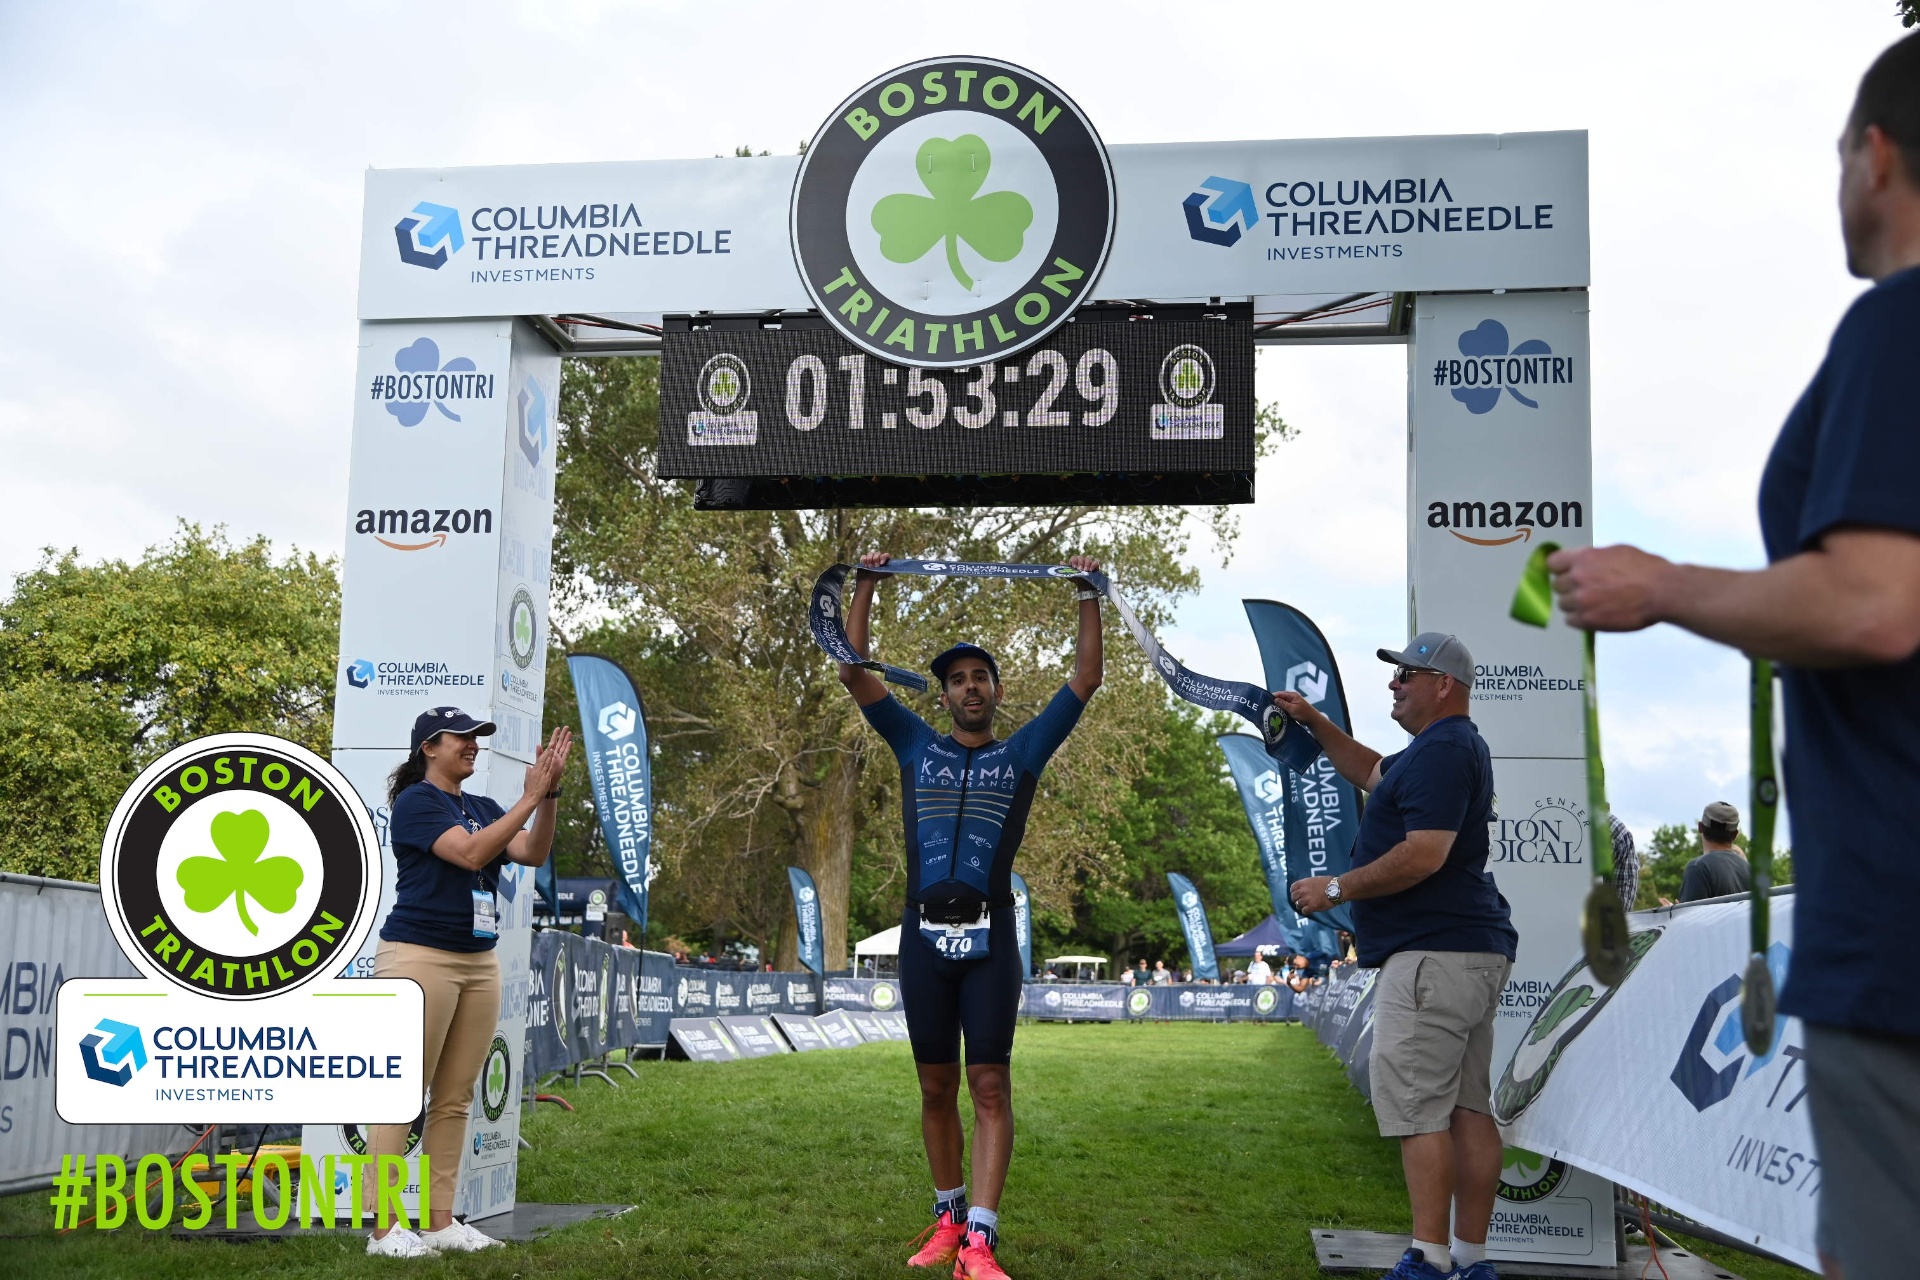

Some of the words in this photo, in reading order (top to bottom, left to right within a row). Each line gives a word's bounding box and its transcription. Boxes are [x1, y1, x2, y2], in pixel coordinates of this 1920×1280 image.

[844, 69, 1063, 142] BOSTON
[1265, 177, 1453, 208] COLUMBIA
[472, 202, 643, 233] COLUMBIA
[1266, 204, 1554, 238] THREADNEEDLE
[472, 229, 732, 261] THREADNEEDLE
[1267, 244, 1403, 261] INVESTMENTS
[470, 267, 595, 283] INVESTMENTS
[823, 255, 1085, 356] TRIATHLON
[1433, 356, 1574, 387] #BOSTONTRI
[371, 373, 495, 400] #BOSTONTRI
[785, 348, 1119, 432] 01:53:29
[356, 508, 492, 534] amazon
[1427, 501, 1583, 529] amazon
[378, 662, 448, 674] COLUMBIA
[378, 674, 485, 686] THREADNEEDLE
[1475, 665, 1544, 677] OLUMBIA
[1176, 677, 1259, 711] THREADNEEDLE
[1177, 671, 1232, 695] COLUMBIA
[1475, 678, 1585, 691] HREADNEEDLE
[921, 756, 1015, 781] KARMA
[591, 750, 611, 822] INVESTMENTS
[621, 741, 649, 843] COLUMBIA
[920, 775, 1015, 790] ENDURANCE
[1535, 796, 1591, 828] CENTER
[1497, 819, 1564, 843] TON
[1492, 839, 1583, 864] DICAL
[935, 936, 972, 953] 470
[825, 993, 866, 1001] ADNEEDLE
[1504, 980, 1553, 994] UMBIA
[1487, 1236, 1534, 1244] INVESTMENTS
[1488, 1223, 1584, 1238] THREADNEEDLE
